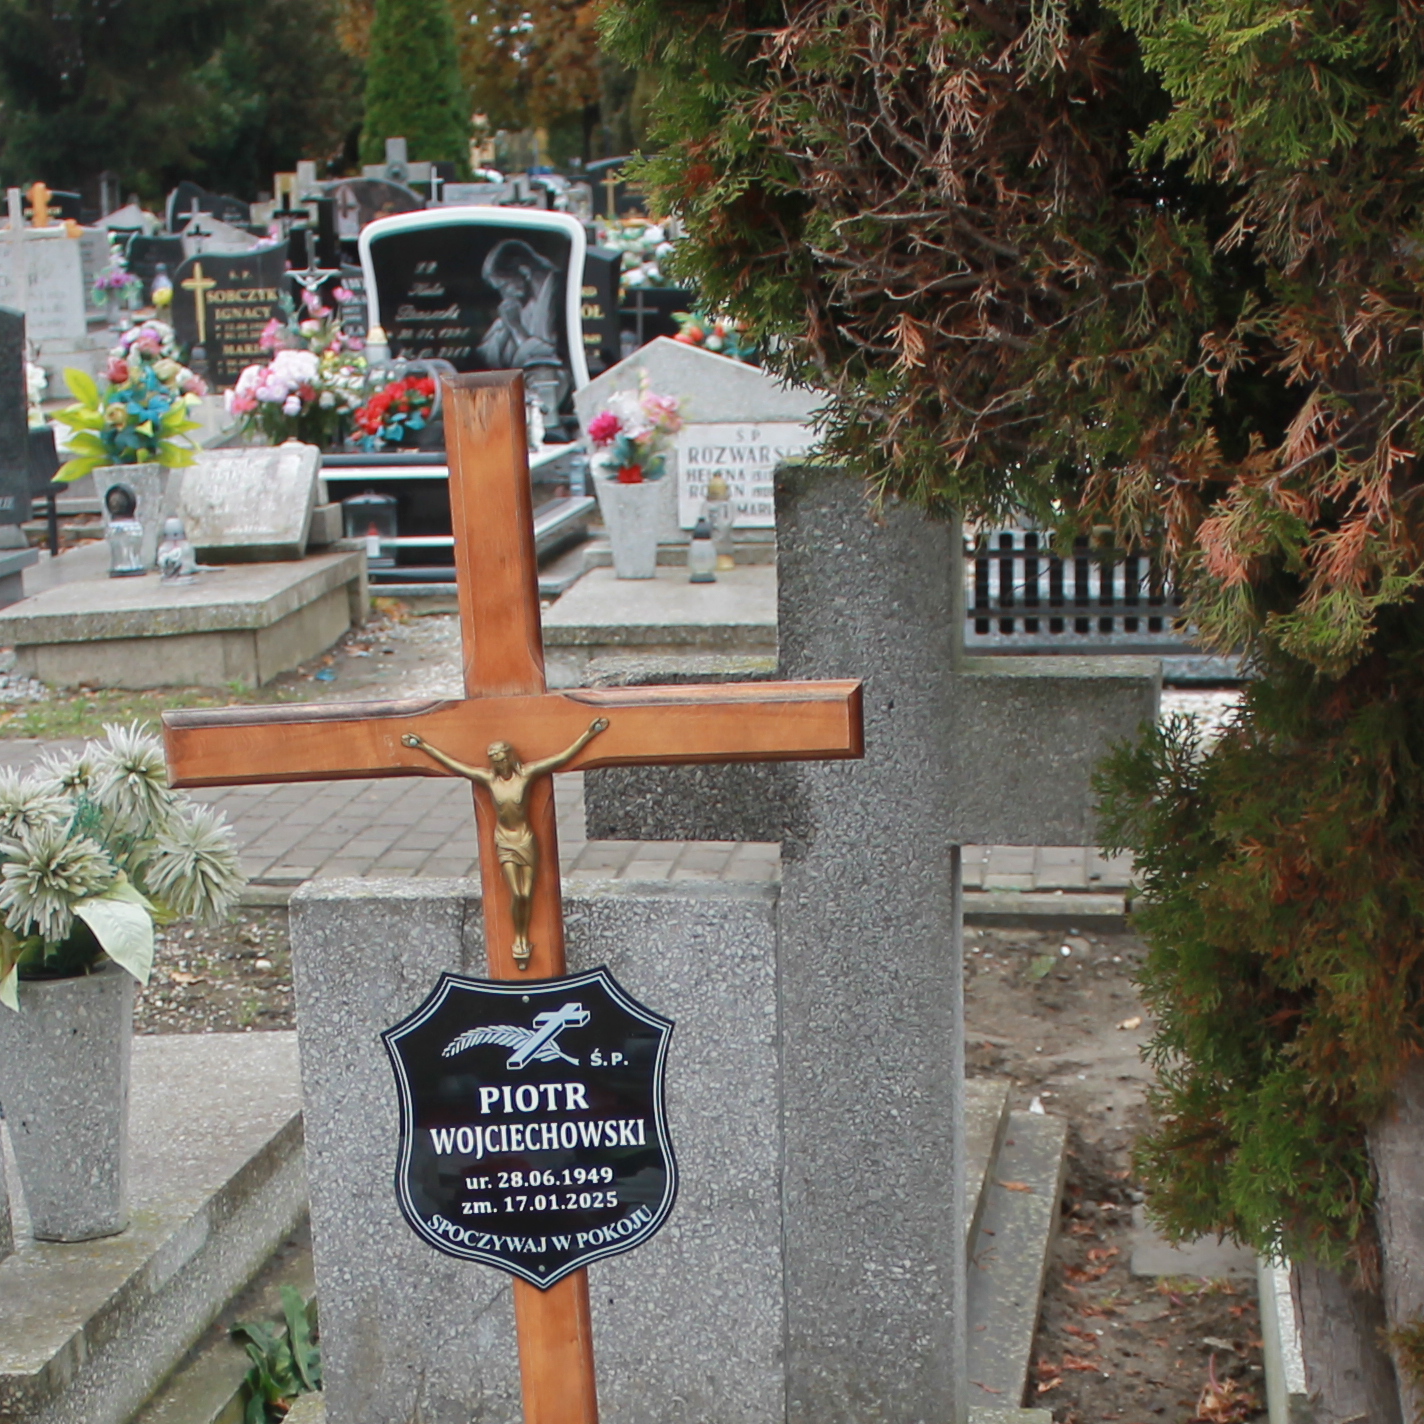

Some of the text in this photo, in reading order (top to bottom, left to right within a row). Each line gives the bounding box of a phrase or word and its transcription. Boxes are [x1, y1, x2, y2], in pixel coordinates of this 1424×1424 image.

[205, 287, 278, 304] SOBCZYK
[214, 305, 272, 321] IGNACY
[479, 1082, 589, 1115] PIOTR
[429, 1118, 647, 1160] WOJCIECHOWSKI
[465, 1166, 614, 1190] ur. 28.06.1949
[461, 1190, 619, 1215] zm. 17.01.2025
[427, 1204, 654, 1253] SPOCZYWAJ W POKOJU
